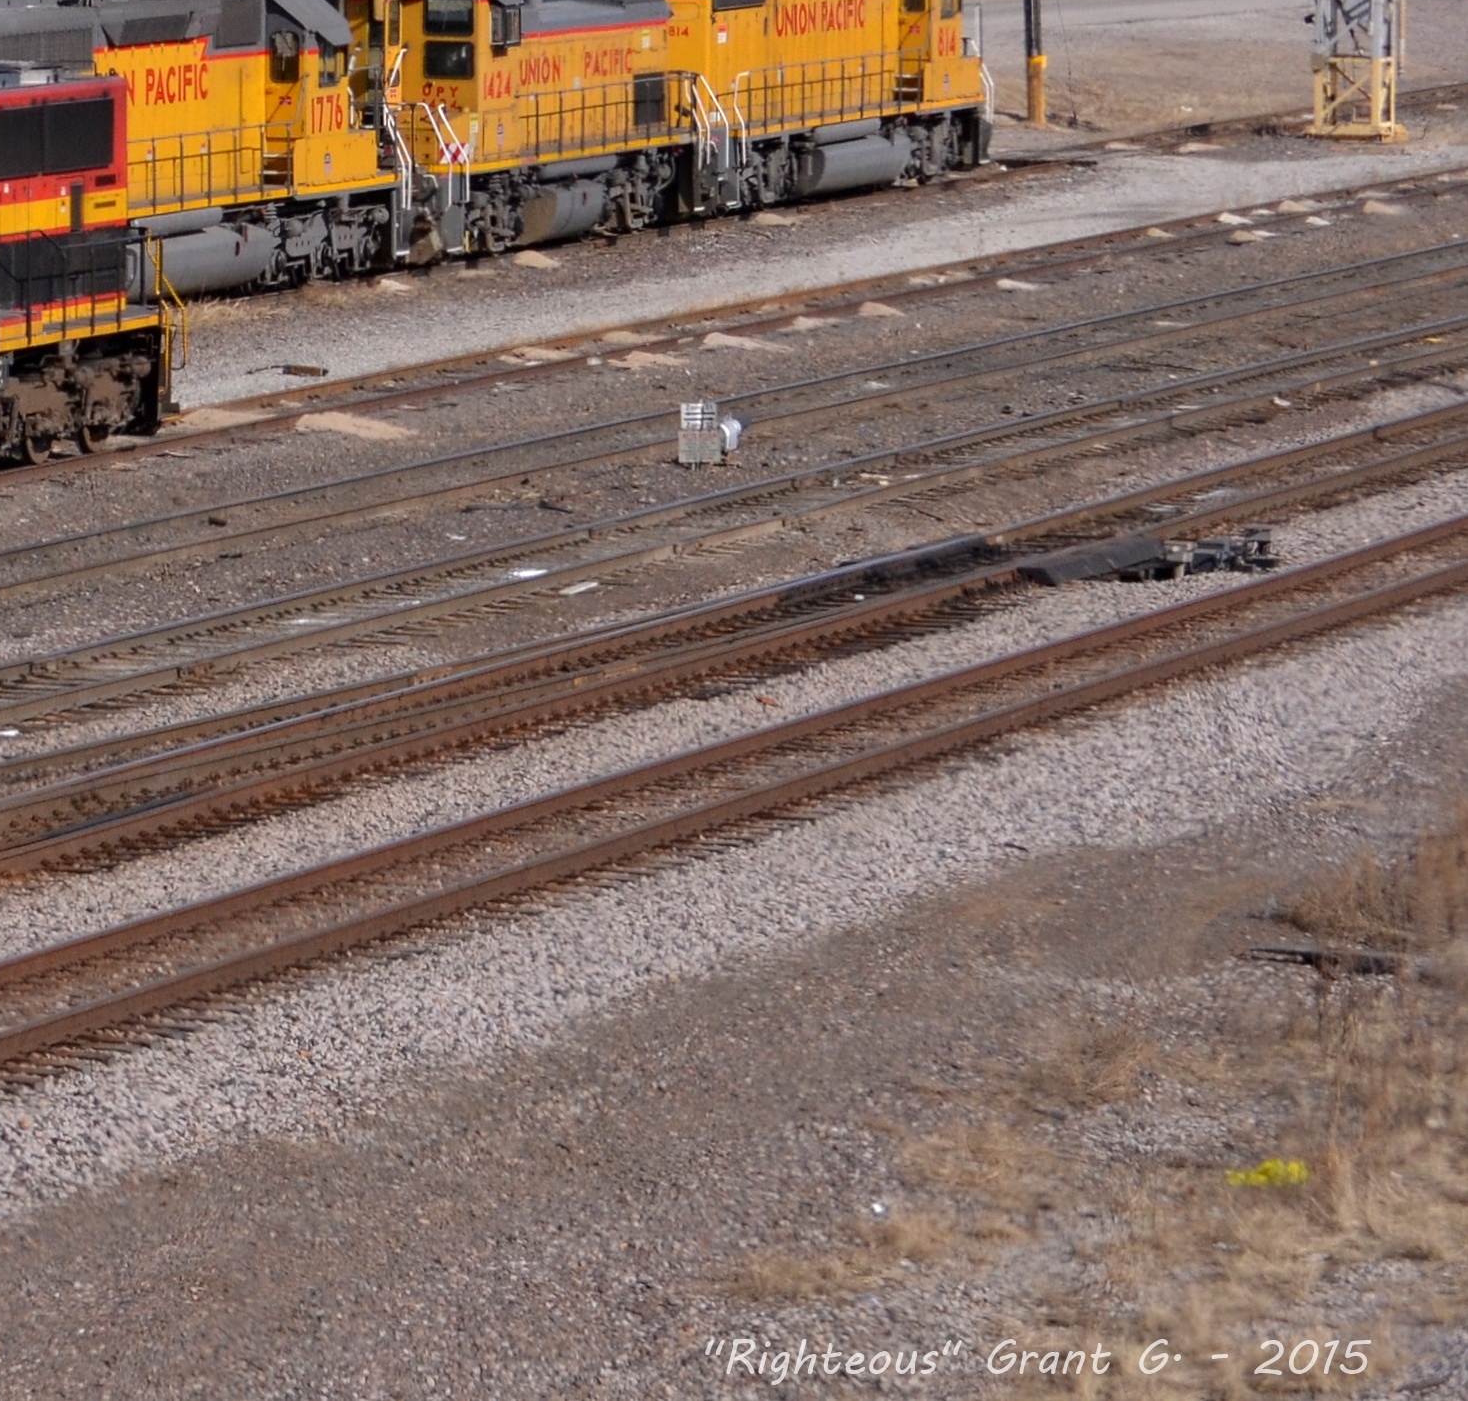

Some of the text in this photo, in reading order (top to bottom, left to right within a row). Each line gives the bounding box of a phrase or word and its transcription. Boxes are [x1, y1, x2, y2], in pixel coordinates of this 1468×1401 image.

[669, 27, 689, 37] 814
[776, 1, 816, 37] UNION
[939, 27, 956, 57] 814
[146, 63, 208, 106] PACIFIC
[520, 48, 634, 86] UNION PACIFIC
[484, 71, 511, 100] 1424
[311, 94, 343, 134] 1776
